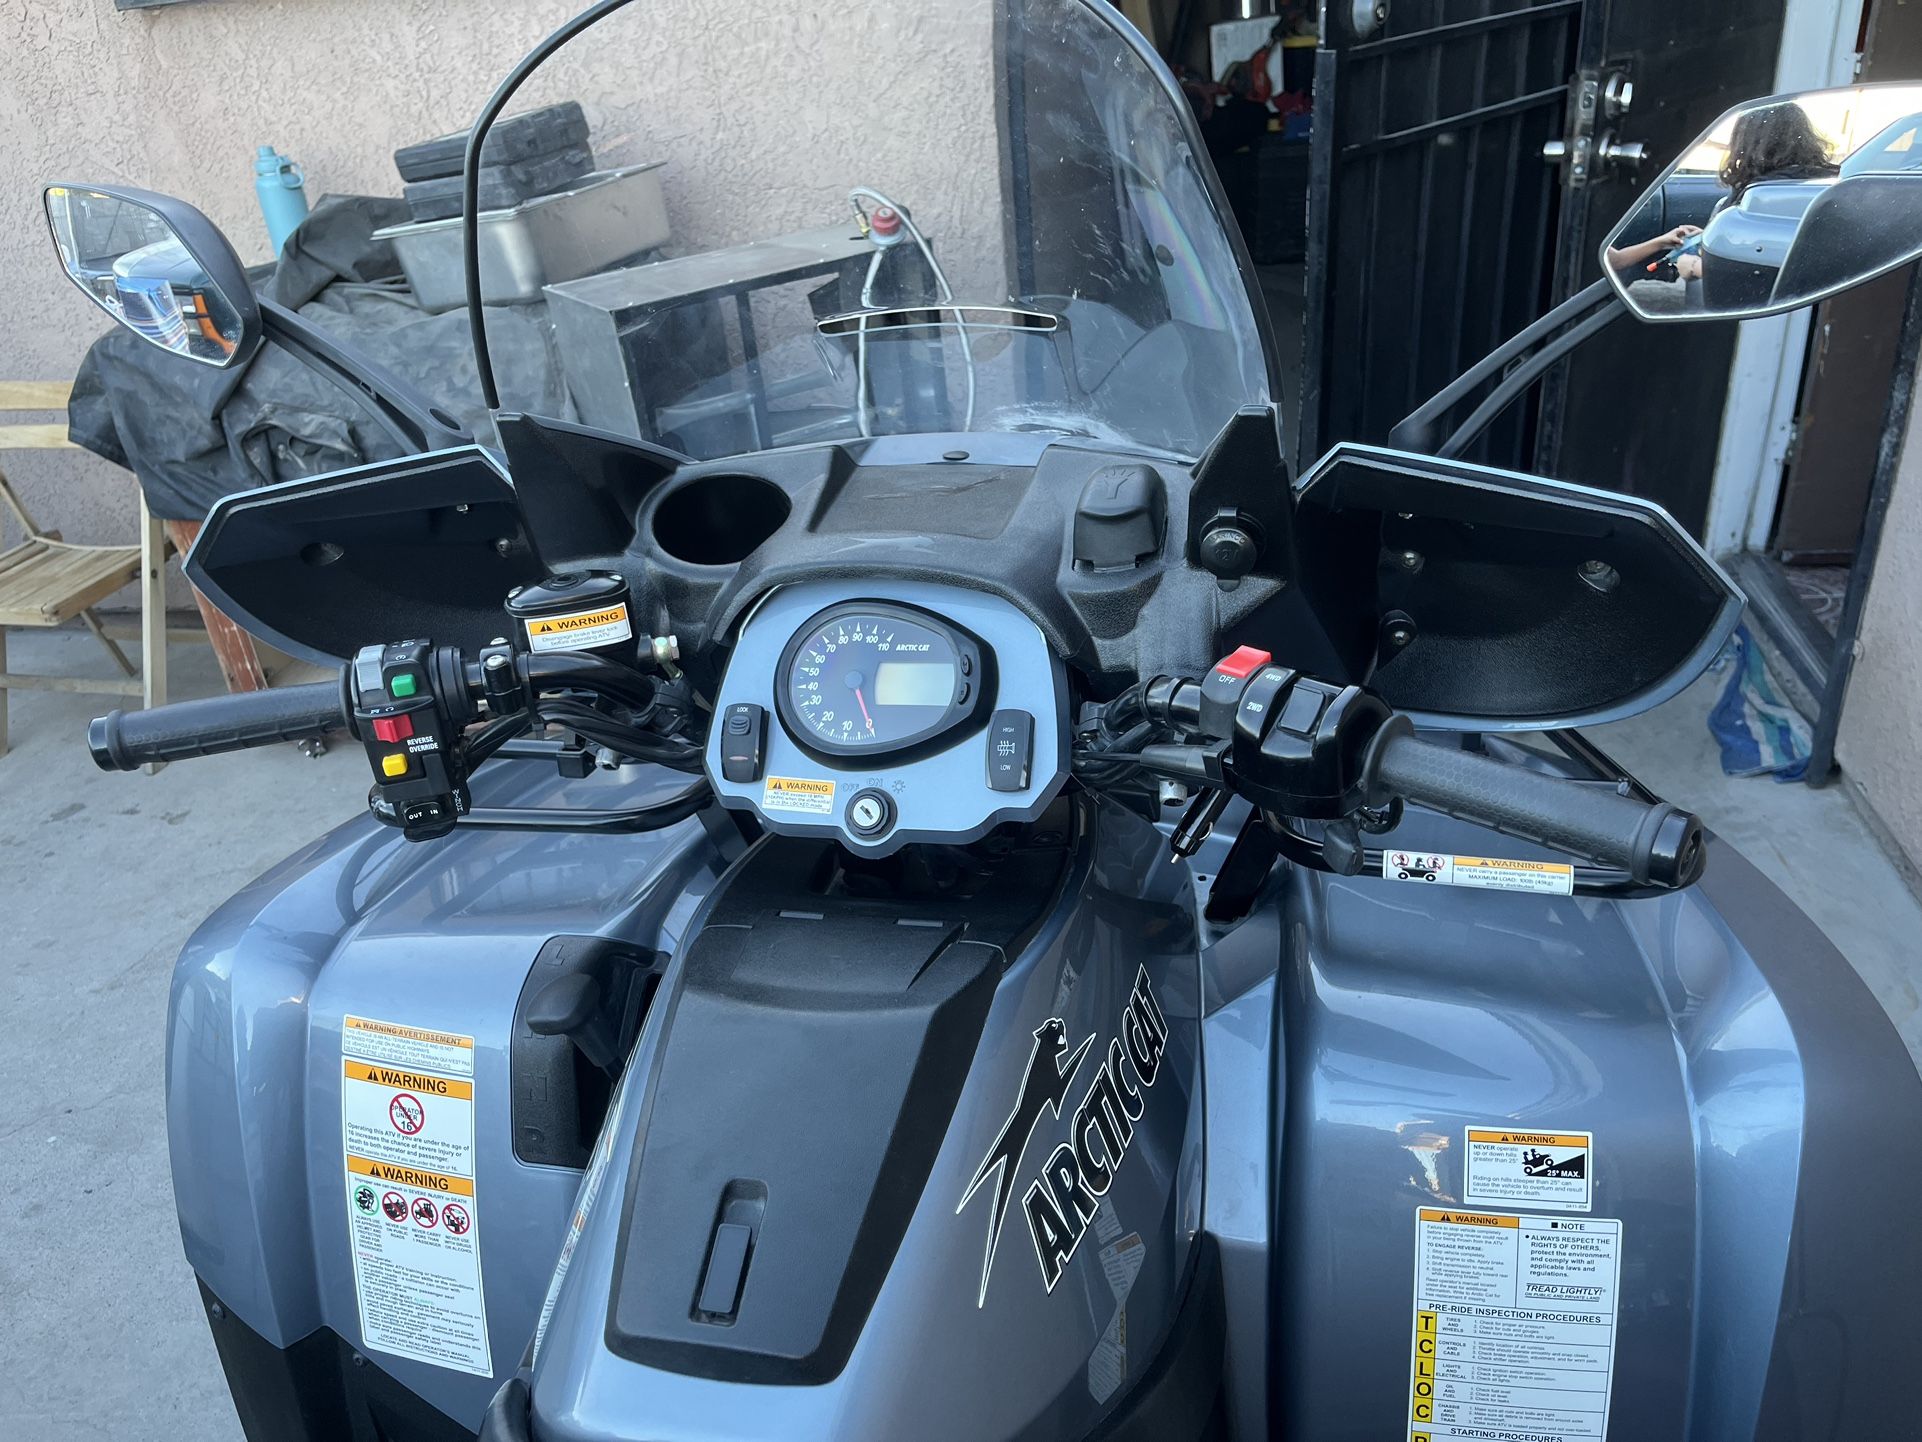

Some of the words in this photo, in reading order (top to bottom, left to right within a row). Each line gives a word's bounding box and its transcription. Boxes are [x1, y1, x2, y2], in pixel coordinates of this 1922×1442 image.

[558, 612, 618, 629] WARNING
[838, 636, 848, 644] 80
[852, 633, 863, 642] 90
[866, 635, 878, 644] 100
[878, 643, 890, 652] 110
[815, 655, 825, 663] 60
[809, 668, 819, 676] 50
[1219, 675, 1236, 684] OFF
[810, 696, 821, 705] 30
[1247, 702, 1263, 712] 2WD
[822, 712, 834, 721] 20
[842, 721, 852, 730] 10
[866, 718, 872, 728] 0
[407, 736, 433, 746] REVERSE
[409, 743, 438, 753] OVERRIDE
[787, 782, 828, 792] WARNING
[452, 789, 463, 812] WINCH
[1491, 860, 1544, 870] WARNING
[381, 1070, 447, 1094] WARNING
[348, 1122, 372, 1134] Operating
[401, 1121, 412, 1131] 16
[1021, 1037, 1145, 1295] ARCTIC
[1122, 962, 1169, 1087] CAT
[355, 1131, 379, 1141] increases
[438, 1148, 454, 1157] injury
[1512, 1135, 1555, 1143] WARNING
[383, 1145, 405, 1153] operator
[419, 1153, 449, 1162] passenger.
[383, 1166, 448, 1190] WARNING
[1456, 1216, 1498, 1224] WARNING
[1429, 1303, 1472, 1314] PRE-RIDE
[1476, 1308, 1532, 1319] INSPECTION
[1536, 1313, 1601, 1323] PROCEDURES
[1421, 1316, 1433, 1330] T
[1419, 1339, 1433, 1353] C
[1420, 1362, 1431, 1376] L
[1416, 1382, 1431, 1396] O
[1416, 1404, 1429, 1418] C
[1451, 1428, 1495, 1438] STARTING
[1499, 1432, 1562, 1442] PROCEDURES
